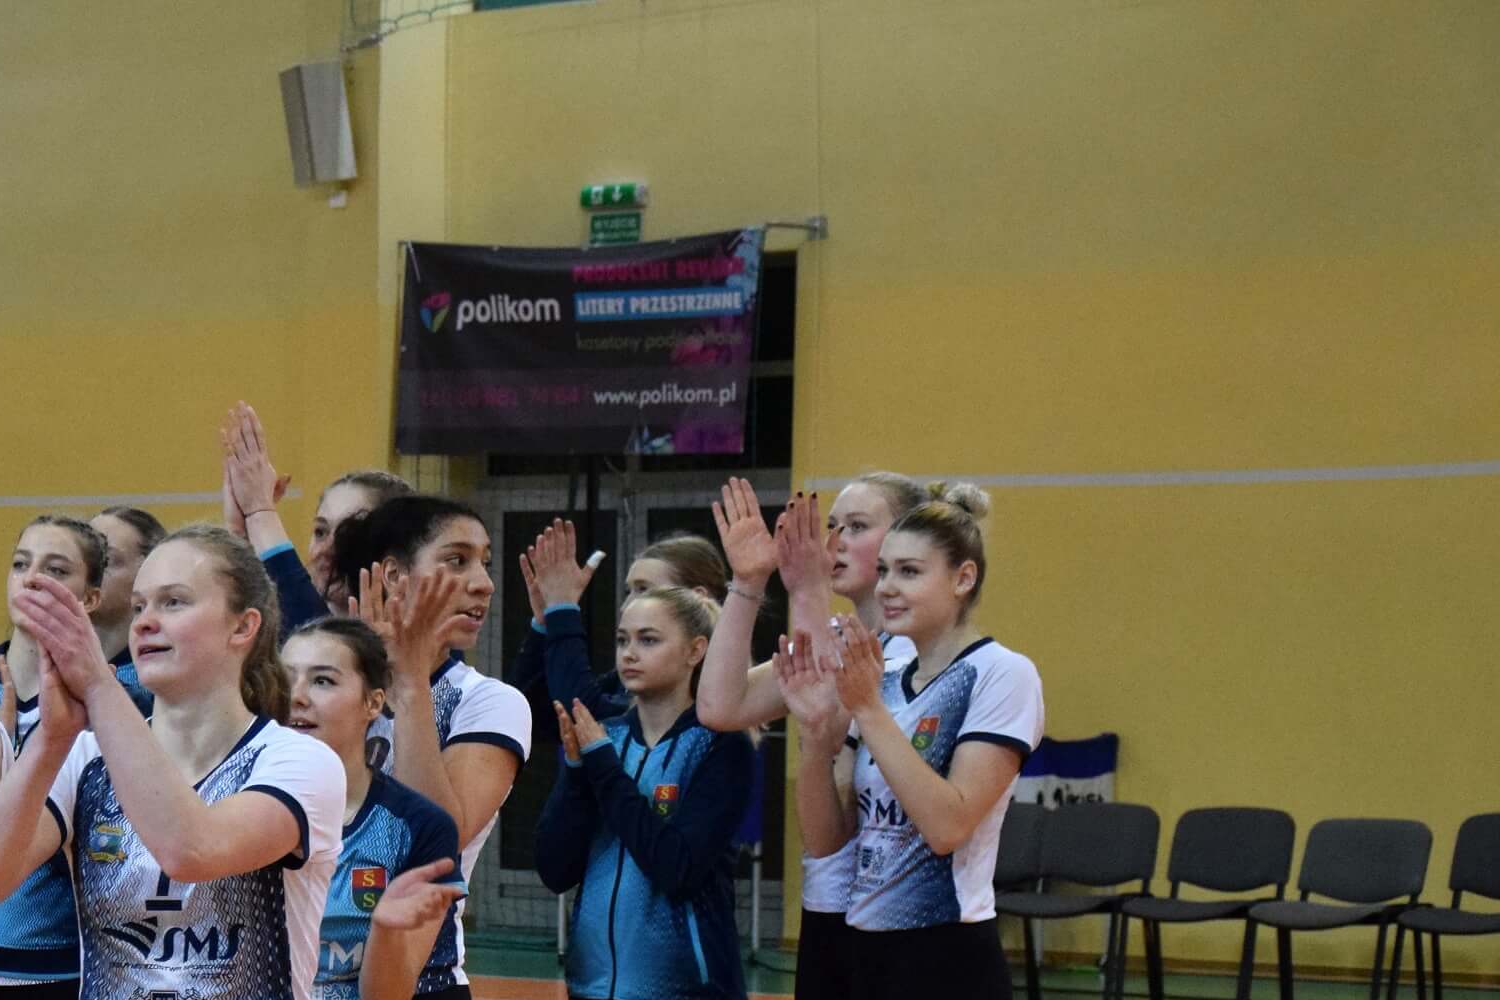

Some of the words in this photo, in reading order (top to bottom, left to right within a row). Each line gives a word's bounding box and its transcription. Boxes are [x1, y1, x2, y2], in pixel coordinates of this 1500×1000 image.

[456, 293, 561, 331] polikom
[578, 297, 624, 316] LITERY
[630, 291, 742, 313] PRZESTRZENNE
[593, 381, 737, 409] www.polikom.pl
